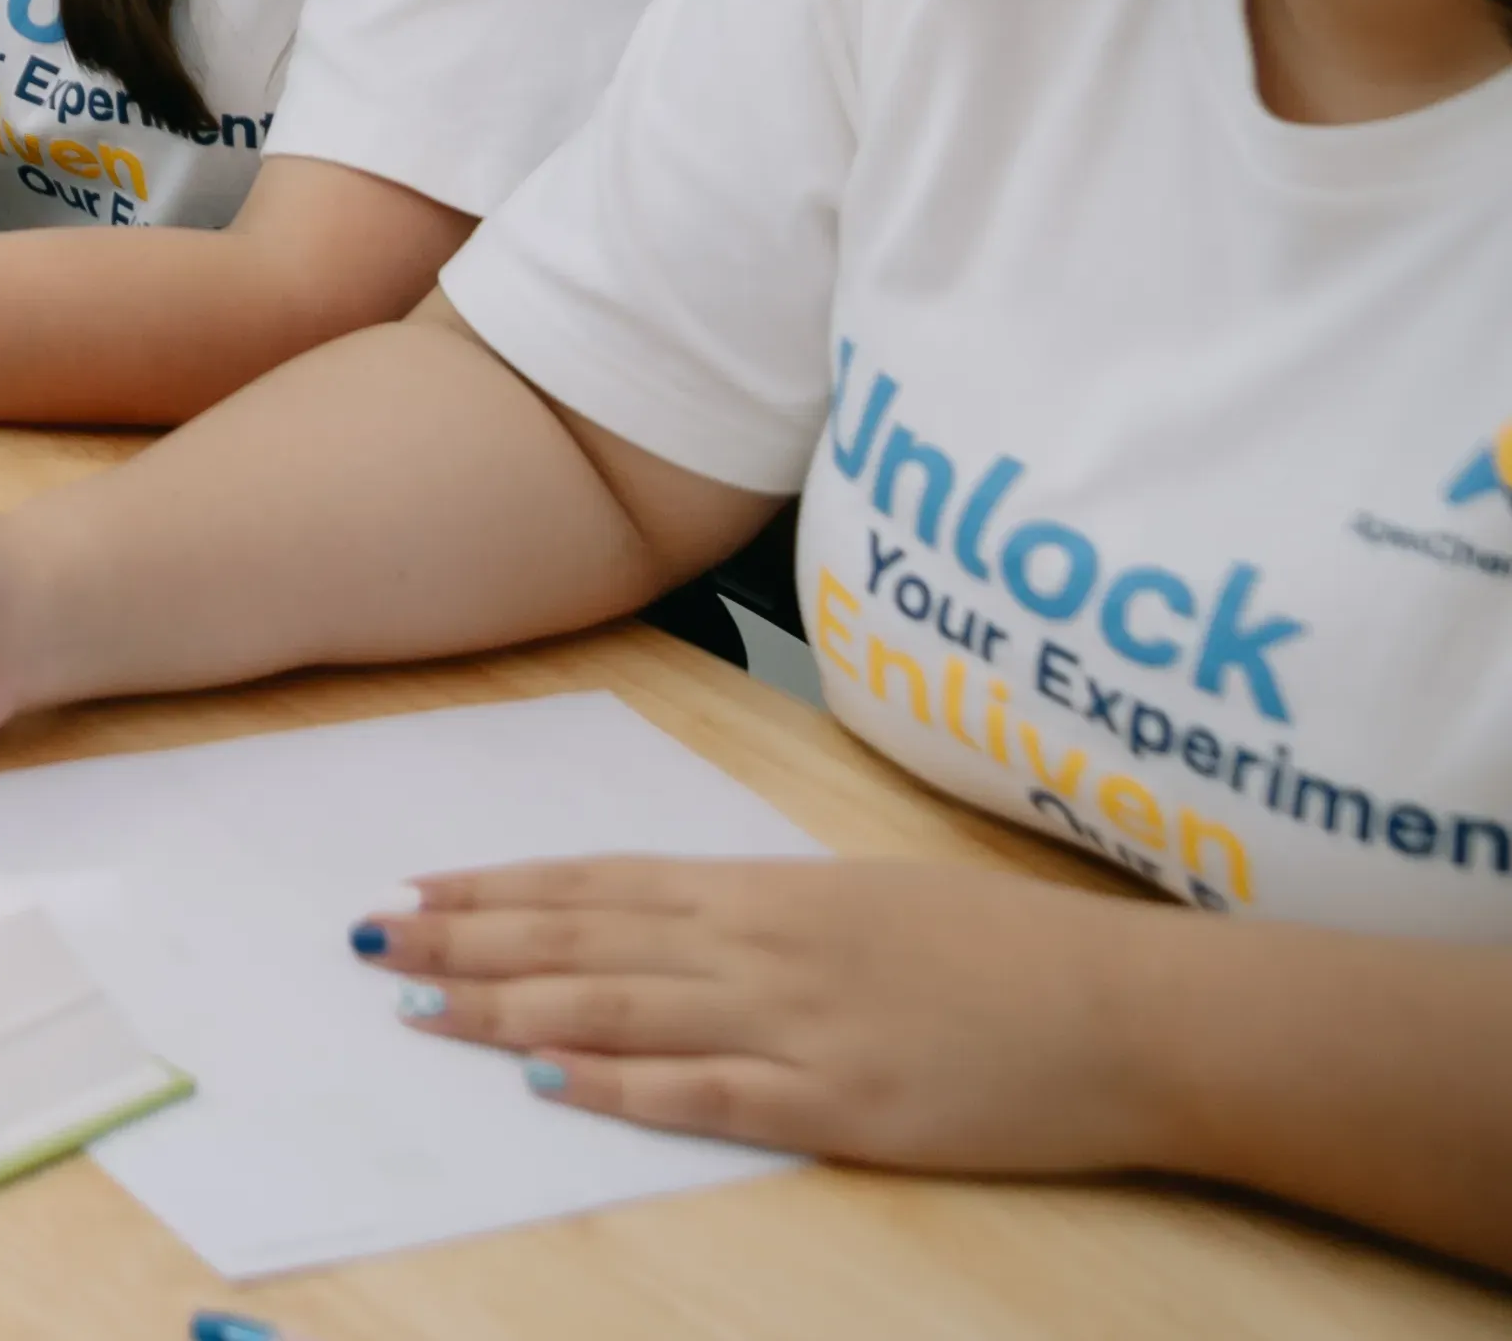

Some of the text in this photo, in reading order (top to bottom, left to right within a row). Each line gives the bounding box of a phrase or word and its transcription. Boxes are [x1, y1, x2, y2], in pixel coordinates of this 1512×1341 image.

[17, 164, 102, 217] Our
[830, 337, 1309, 725] Unlock
[863, 528, 1007, 663] Your
[1035, 640, 1512, 878] Experimen
[817, 564, 1255, 906] Enliven
